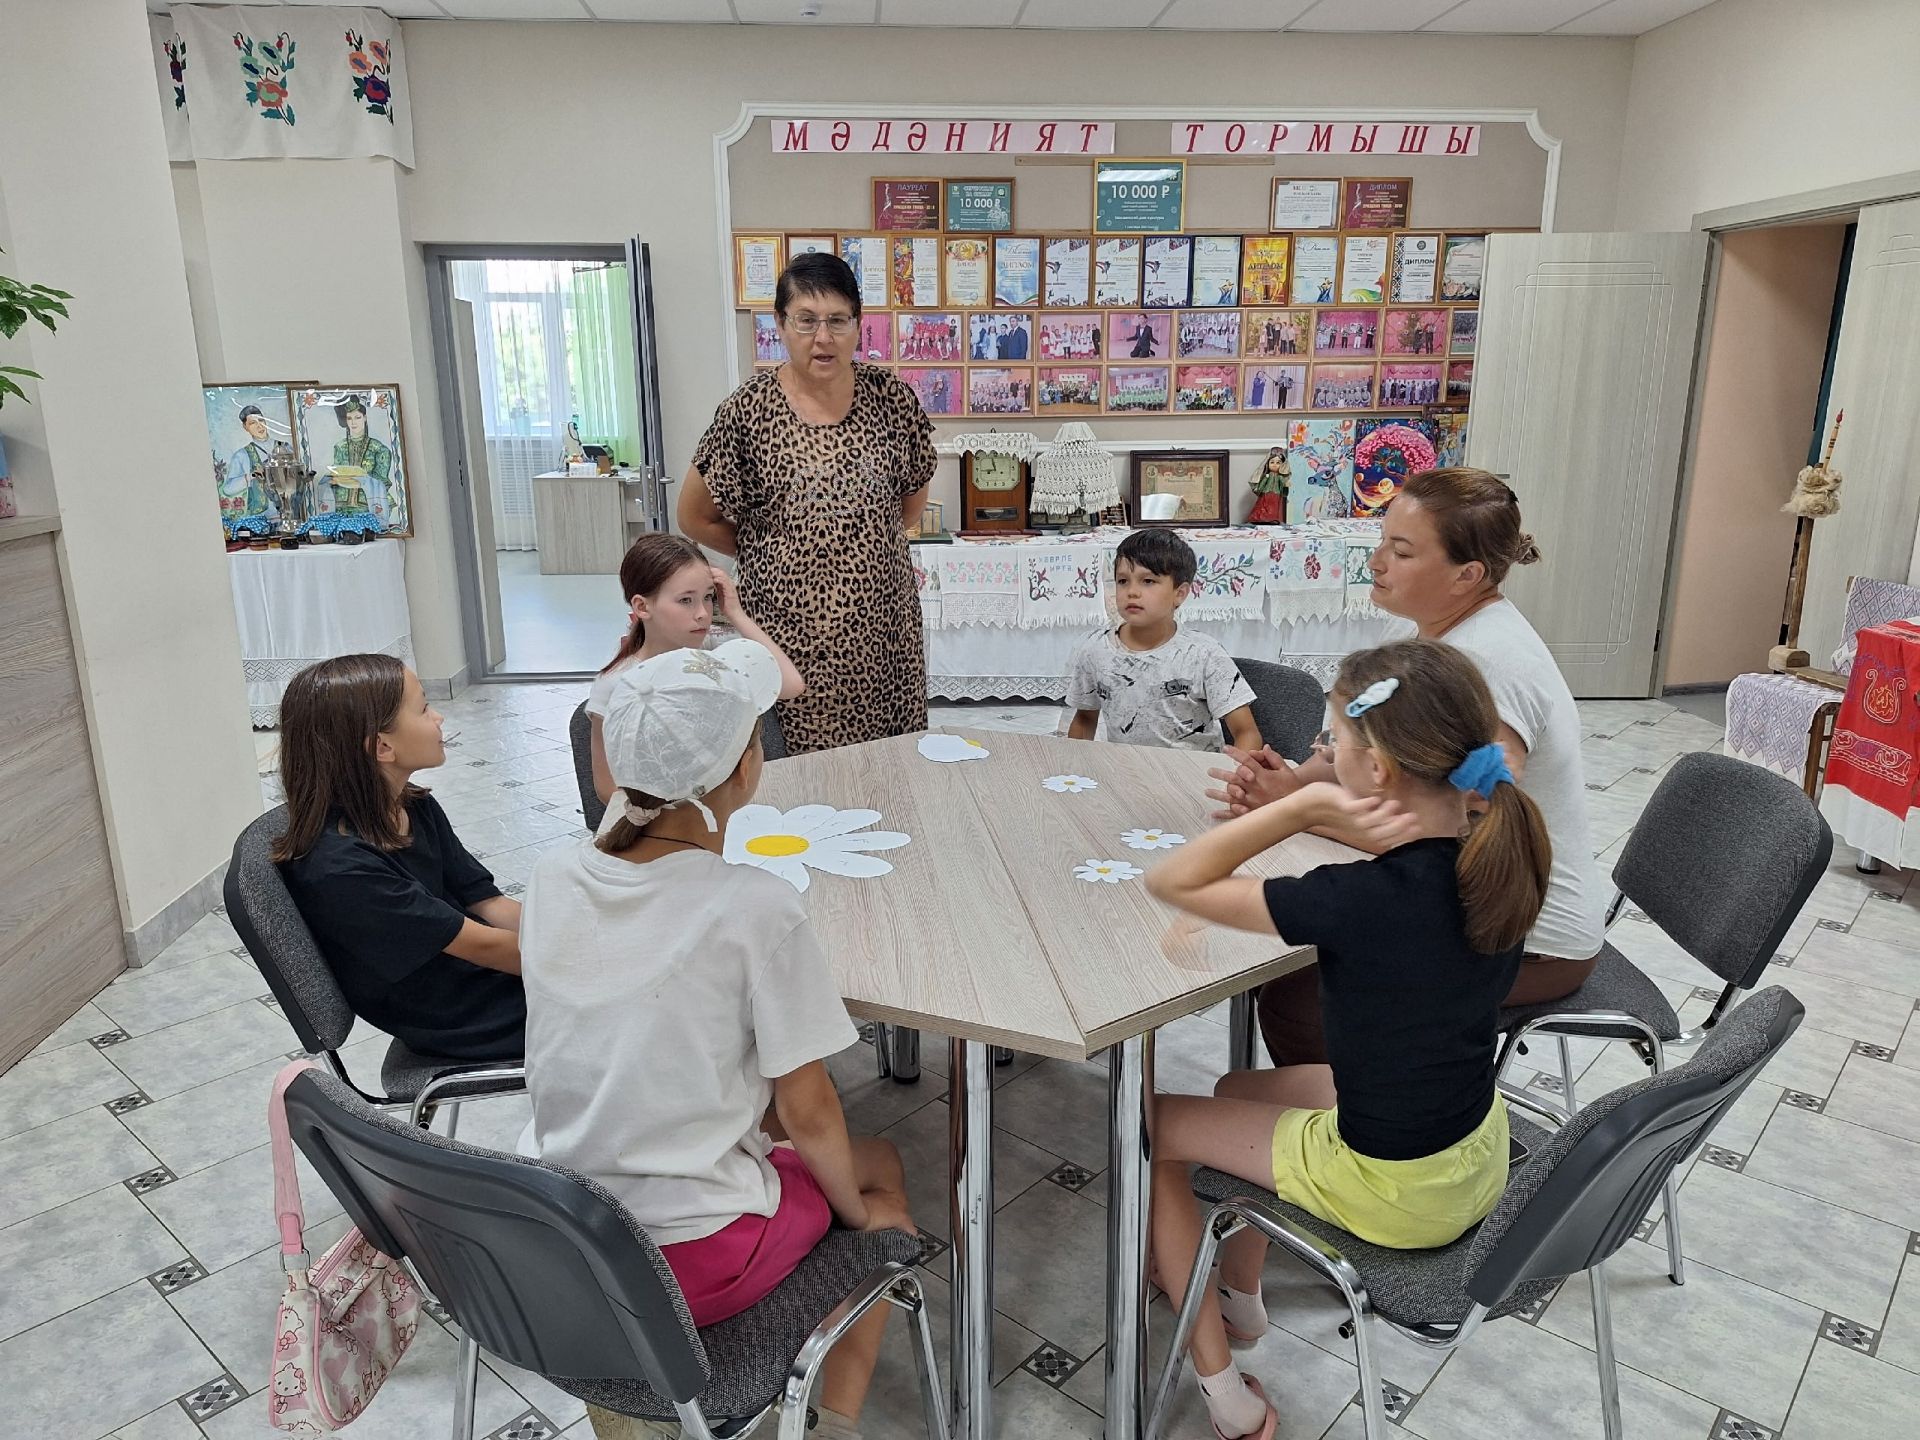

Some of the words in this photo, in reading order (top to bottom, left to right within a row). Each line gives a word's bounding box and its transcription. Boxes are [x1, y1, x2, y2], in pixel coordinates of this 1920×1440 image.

[782, 121, 1099, 152] МӘДӘНИЯТ
[1186, 122, 1475, 155] ТОРМЫШЫ
[1111, 184, 1128, 199] 10
[1131, 184, 1158, 199] 000
[1369, 183, 1398, 191] ДИПЛОМ
[960, 198, 971, 208] 10
[974, 198, 993, 208] 000
[1001, 261, 1035, 269] ДИПЛОМ
[1248, 262, 1284, 270] ДИПЛОМ
